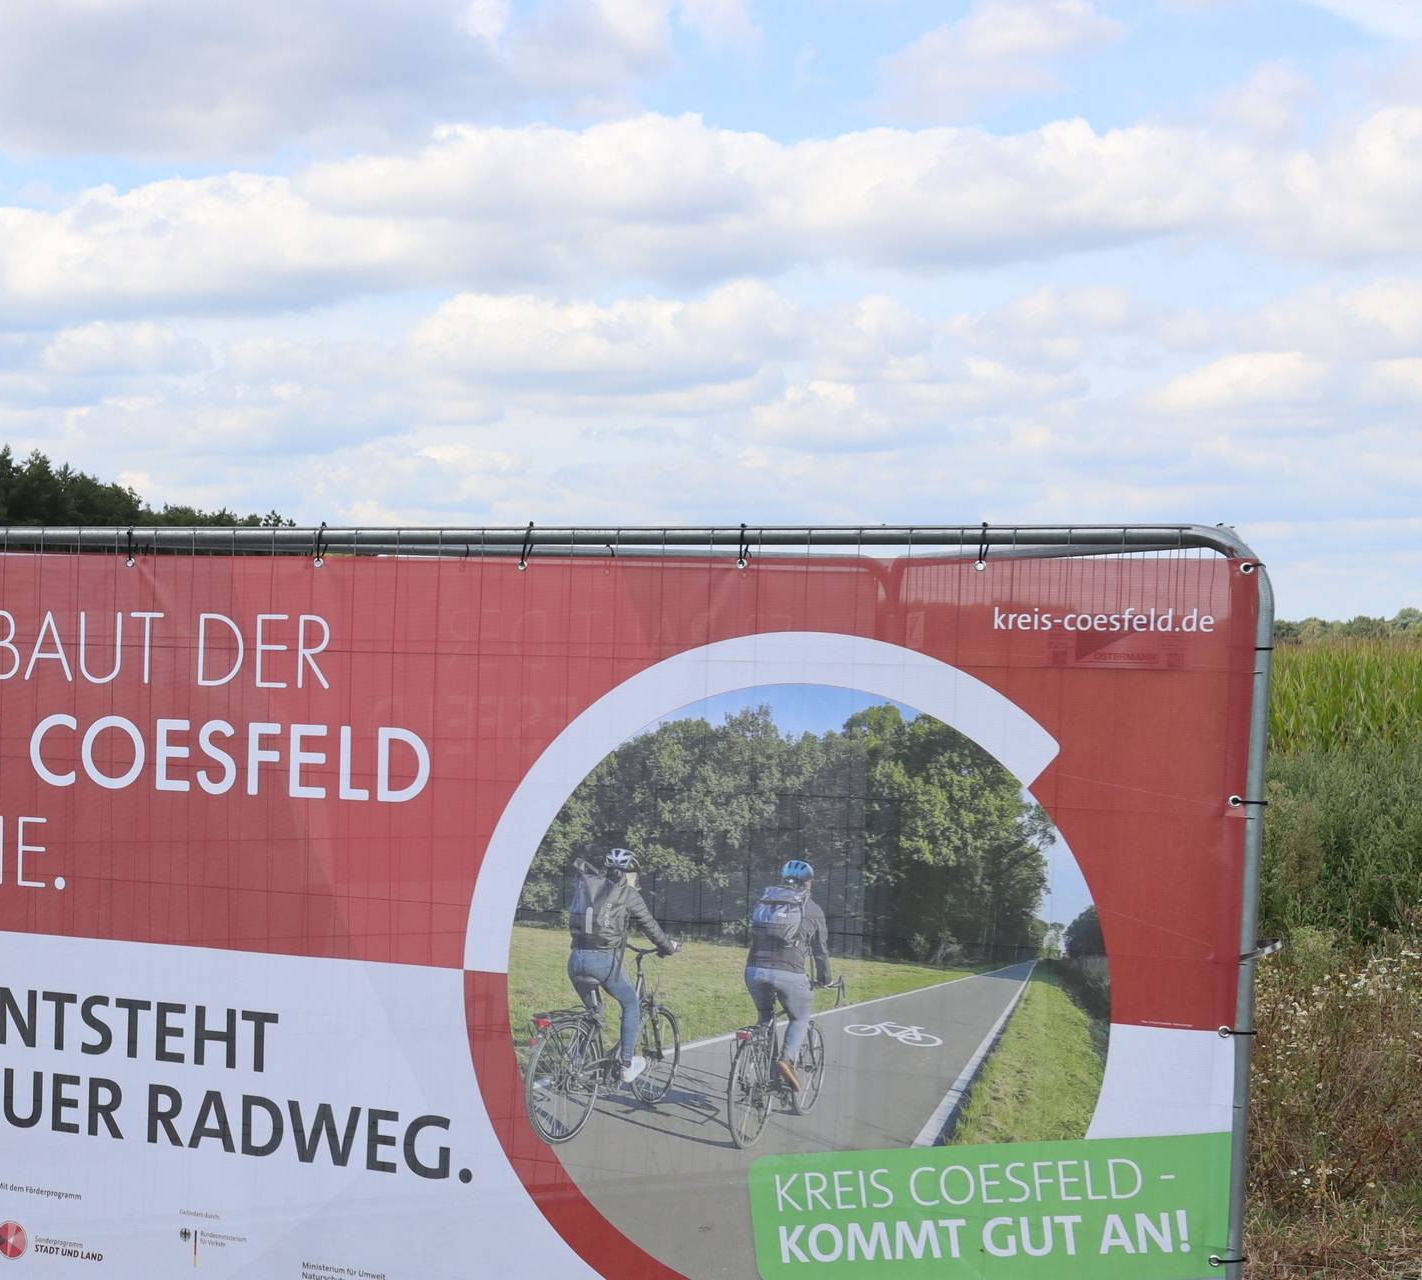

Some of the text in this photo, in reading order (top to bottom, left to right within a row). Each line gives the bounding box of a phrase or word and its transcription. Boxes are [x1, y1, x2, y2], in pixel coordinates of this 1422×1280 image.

[993, 606, 1215, 633] kreis-coesfeld.de
[197, 612, 330, 690] DER
[29, 713, 431, 803] COESFELD
[147, 1083, 473, 1184] RADWEG.
[9, 1184, 24, 1193] dem
[25, 1186, 82, 1201] Förderprogramm
[774, 1168, 894, 1212] KREIS
[909, 1158, 1144, 1207] COESFELD
[34, 1235, 84, 1248] Sonderprogramm
[34, 1244, 104, 1262] STADT UND LAND
[778, 1209, 1191, 1264] KOMMT GUT AN!
[301, 1261, 346, 1274] Ministerium
[346, 1268, 357, 1277] für
